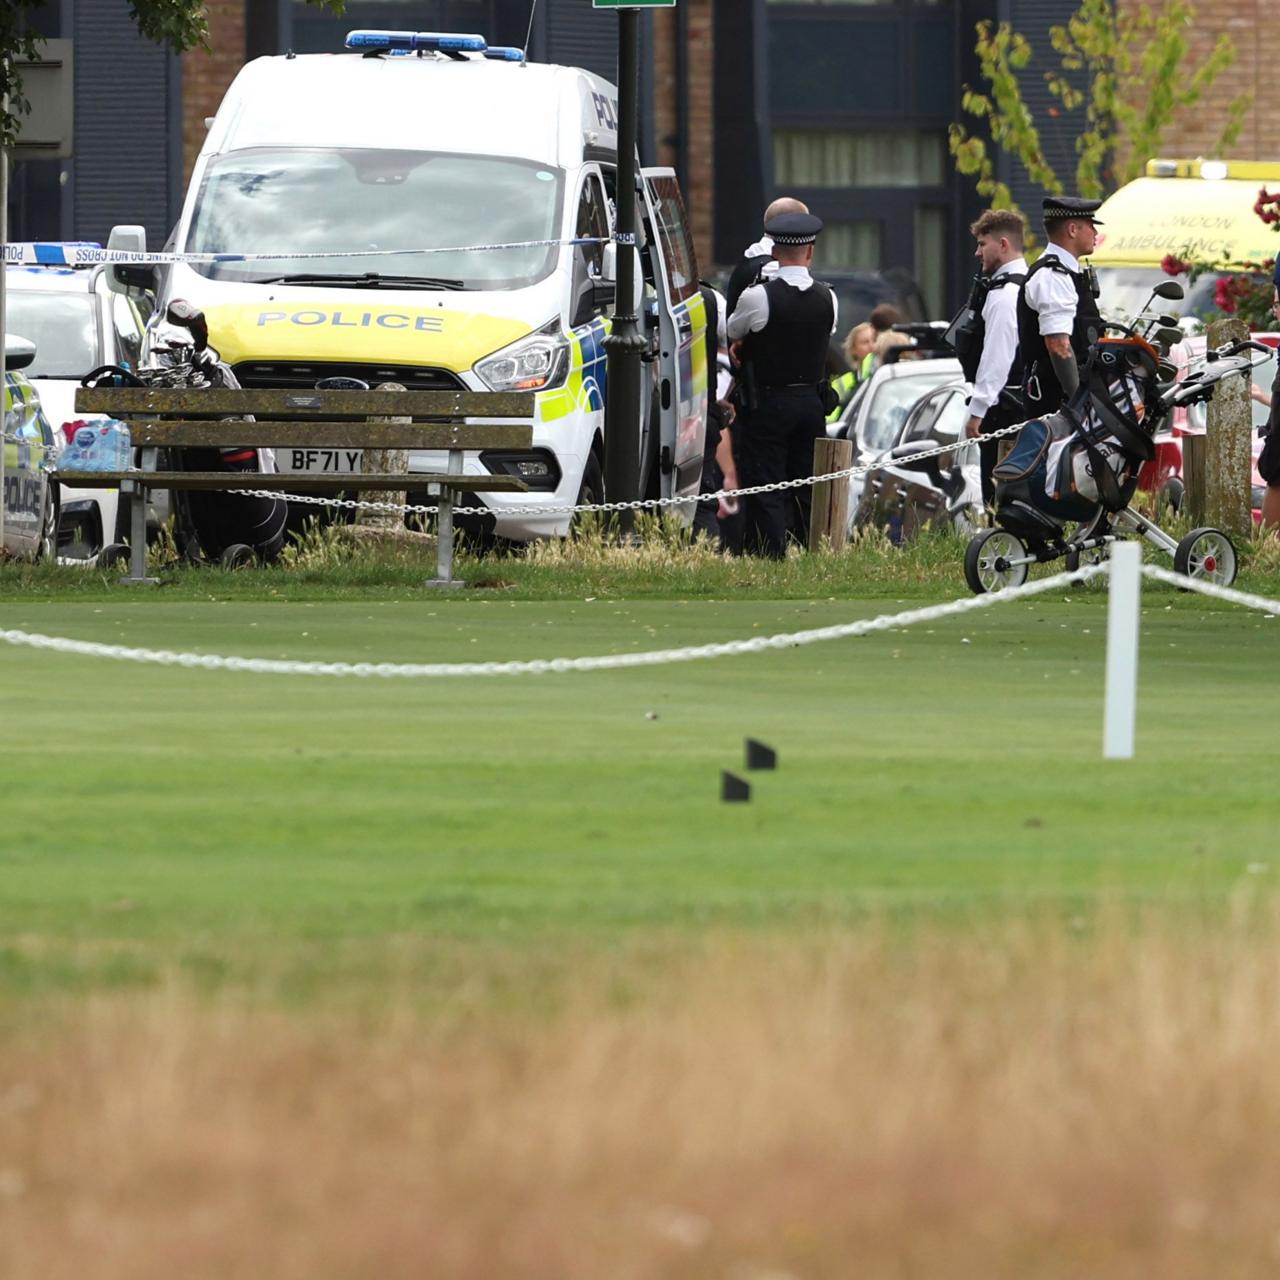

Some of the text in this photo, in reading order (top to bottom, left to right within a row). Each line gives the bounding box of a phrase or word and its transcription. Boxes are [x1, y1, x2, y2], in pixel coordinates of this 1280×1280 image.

[1111, 235, 1239, 253] AMBULANCE
[76, 249, 107, 262] CROSS
[257, 311, 445, 332] POLICE
[292, 450, 339, 471] BF71
